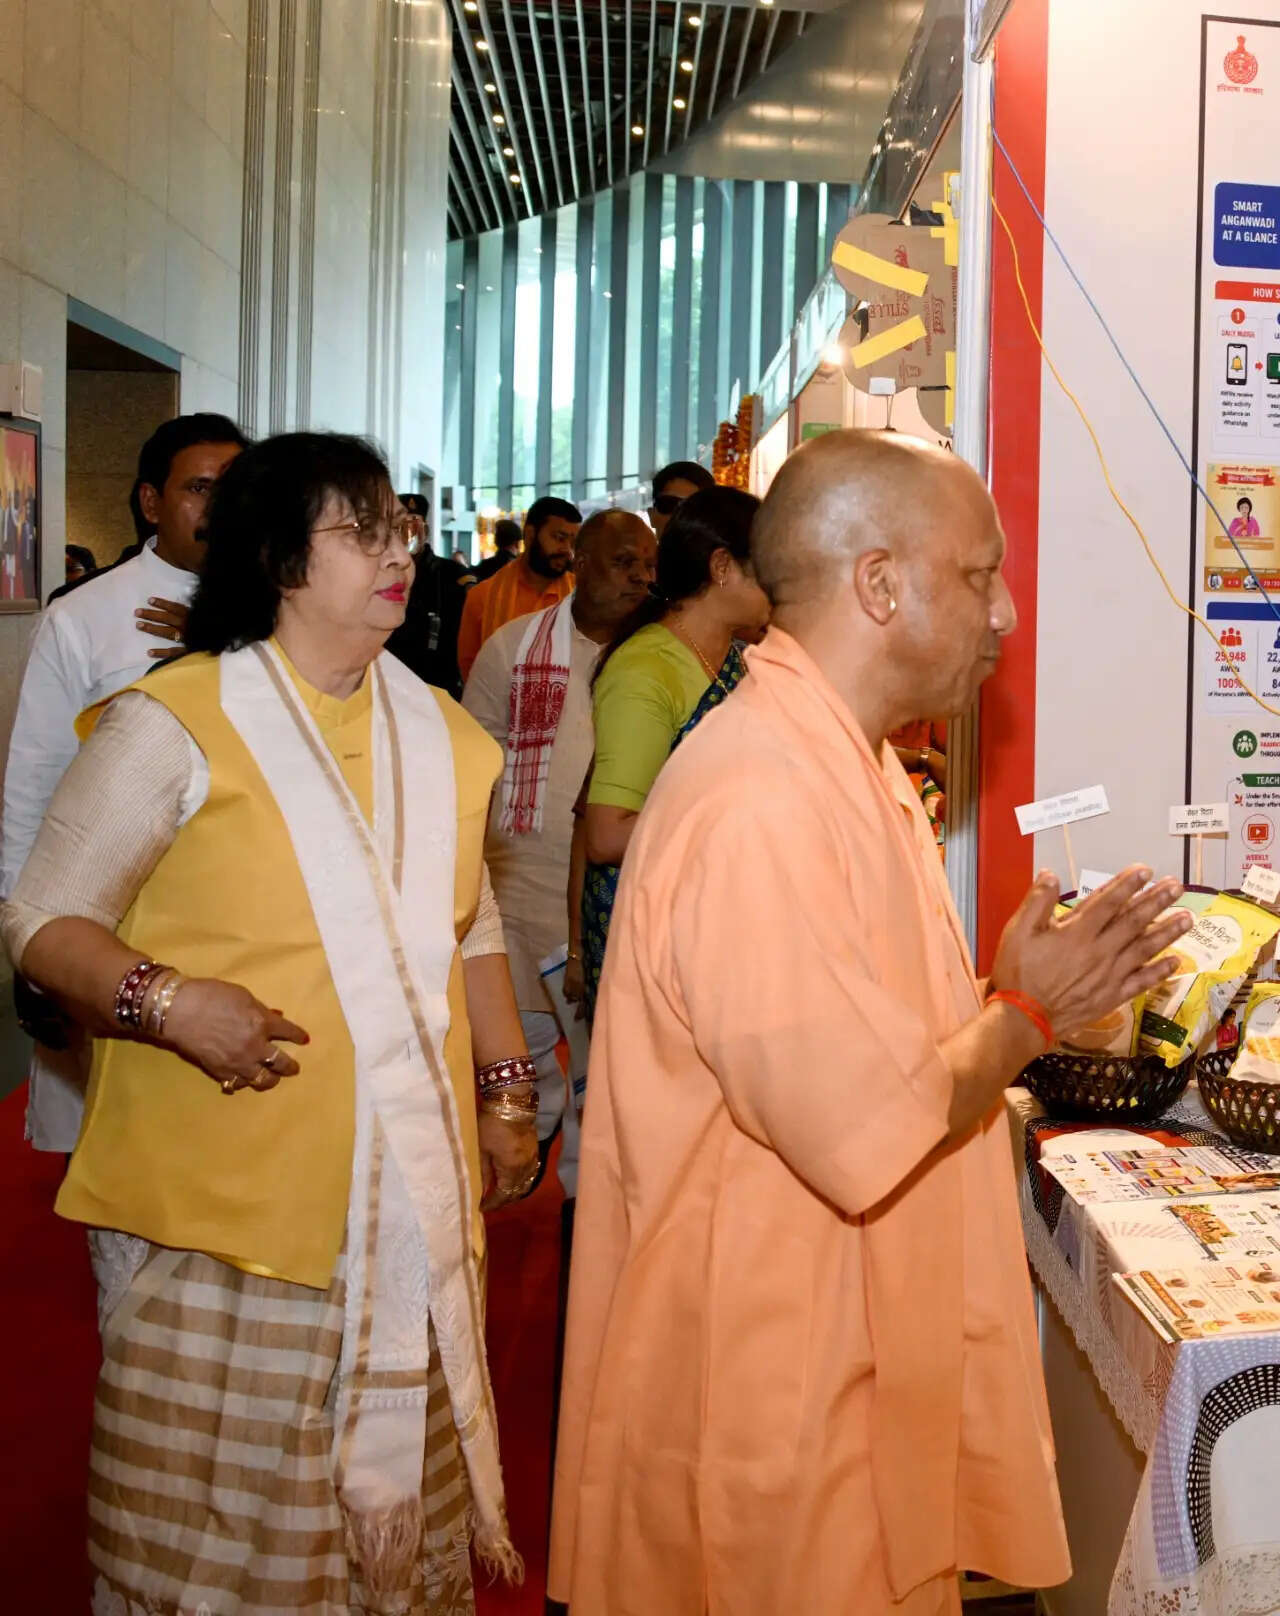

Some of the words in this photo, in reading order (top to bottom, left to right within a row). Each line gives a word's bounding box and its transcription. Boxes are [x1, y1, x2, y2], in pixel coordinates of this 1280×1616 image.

[1233, 200, 1262, 212] SMART
[1221, 215, 1275, 229] ANGANWADI
[1223, 231, 1233, 241] AT
[1235, 231, 1242, 241] A
[1243, 232, 1278, 244] GLANCE
[1253, 288, 1273, 299] HOW
